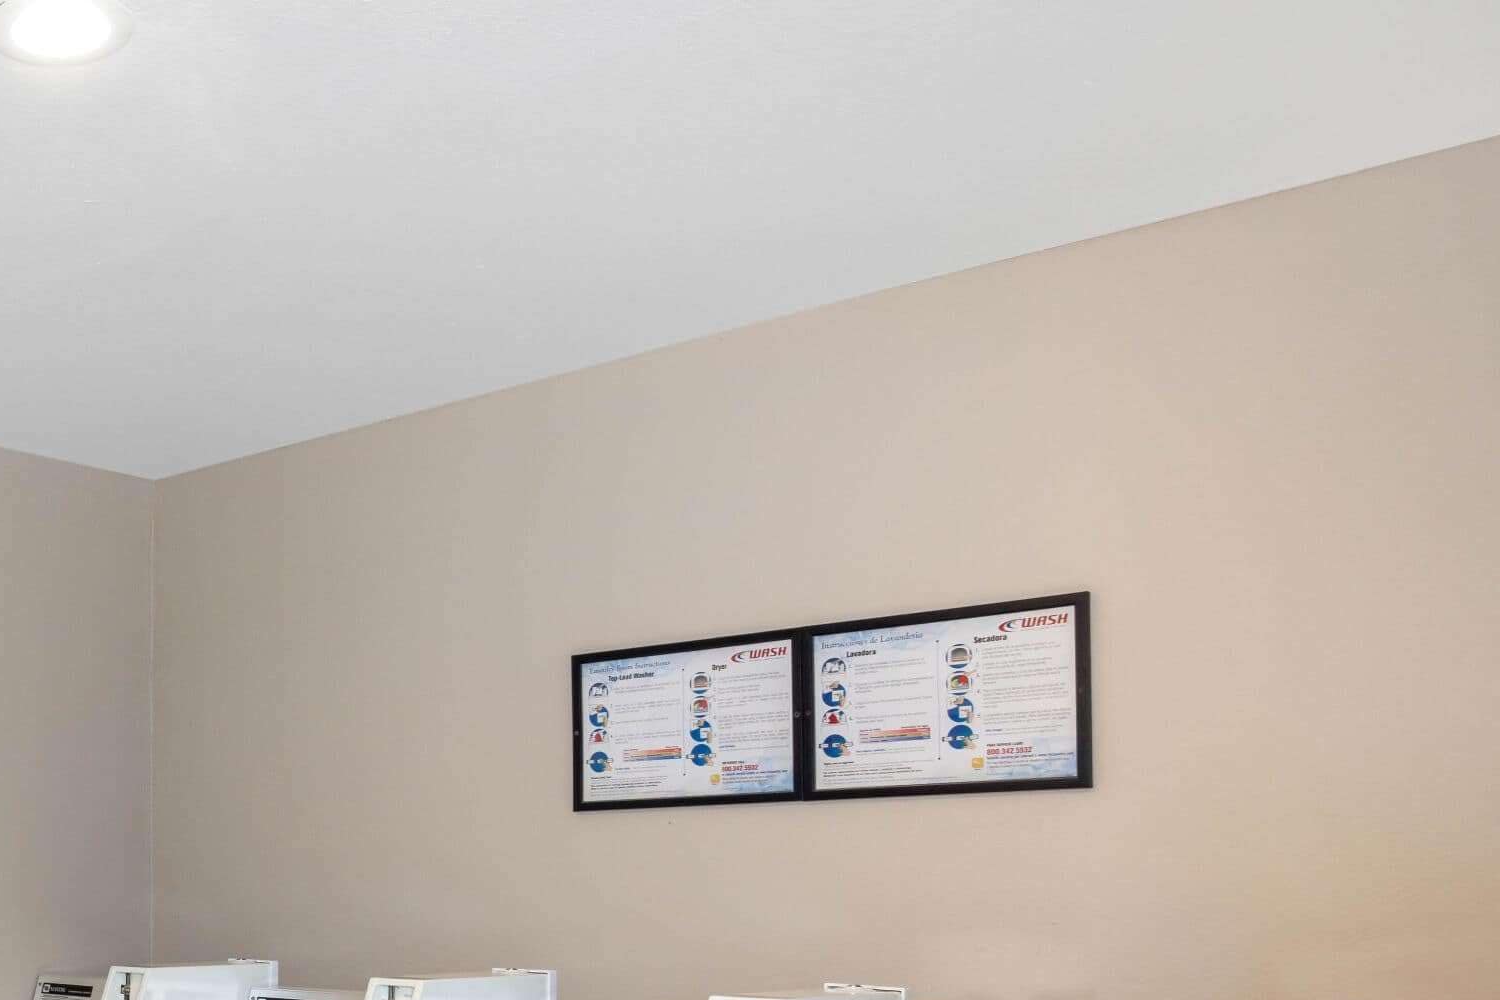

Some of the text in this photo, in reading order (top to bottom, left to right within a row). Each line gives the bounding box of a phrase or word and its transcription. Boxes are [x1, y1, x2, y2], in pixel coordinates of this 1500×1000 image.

[1020, 612, 1068, 628] WASH
[973, 633, 1008, 644] Secadora
[749, 646, 788, 659] WASH
[846, 649, 877, 658] Lavadora
[711, 663, 727, 672] Dryer
